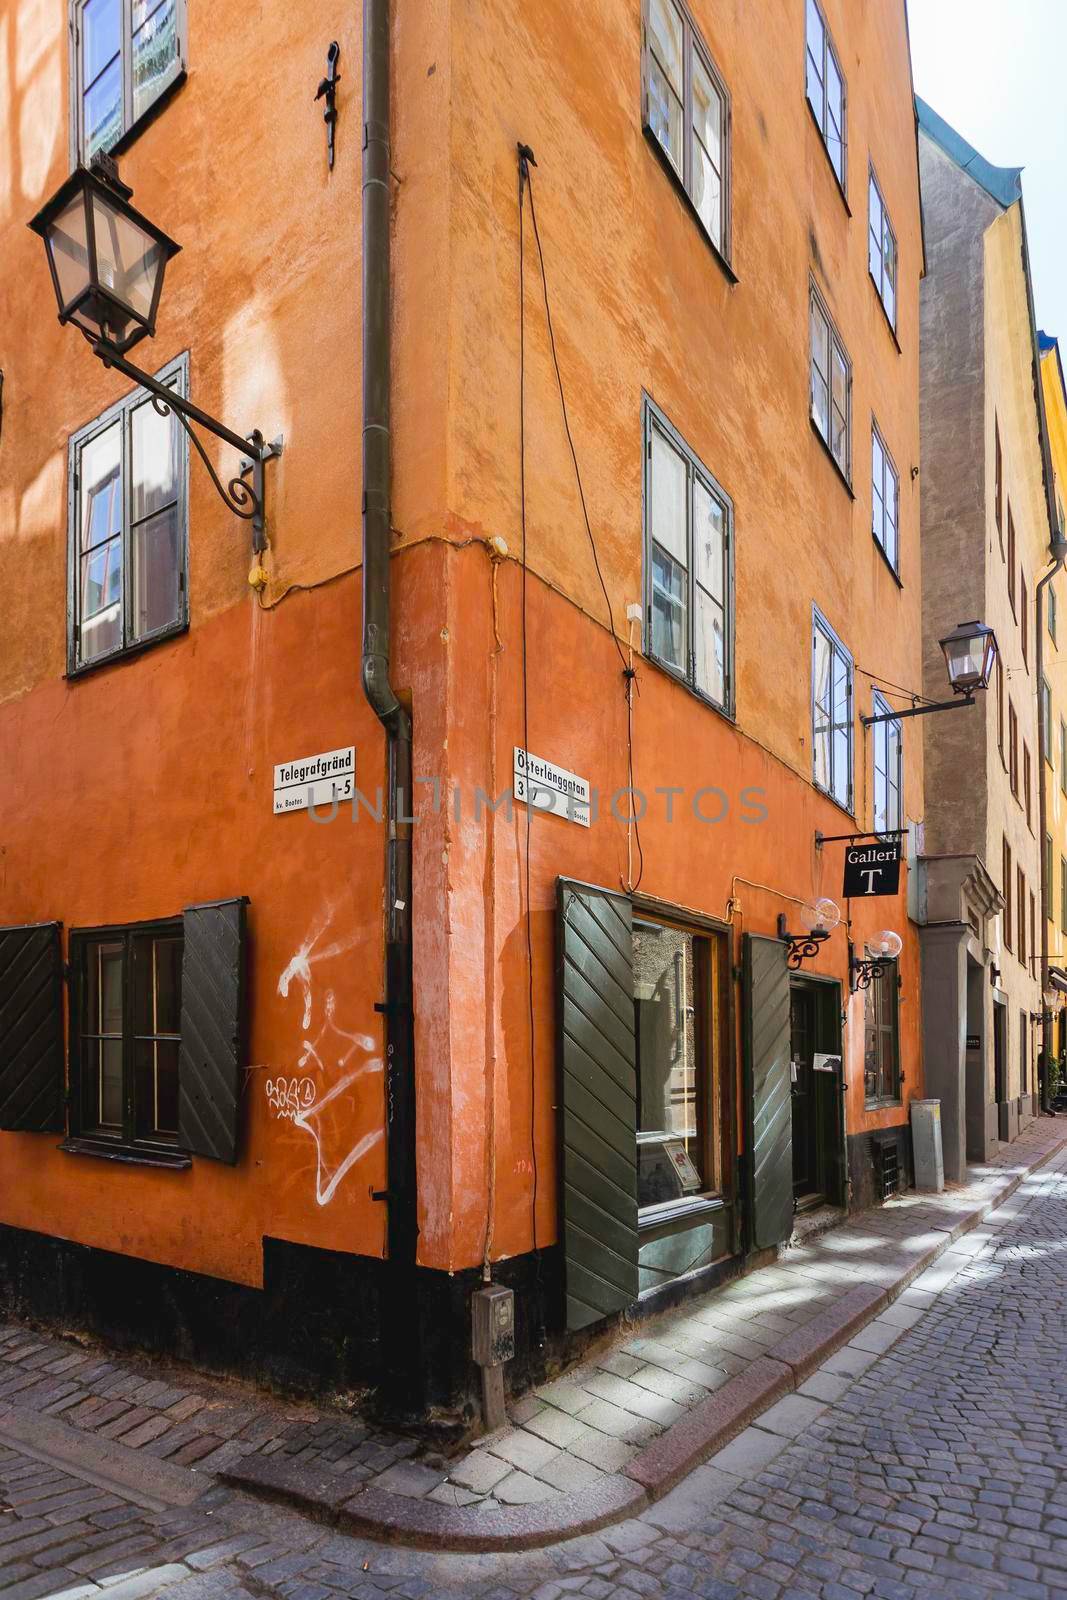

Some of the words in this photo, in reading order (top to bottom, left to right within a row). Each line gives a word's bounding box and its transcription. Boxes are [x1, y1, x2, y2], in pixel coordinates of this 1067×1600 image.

[280, 751, 352, 782] Telegrafgränd
[517, 749, 586, 796] Österlånggatan
[332, 780, 351, 798] 1-5
[285, 799, 303, 808] Bootes
[848, 848, 897, 864] Galleri
[860, 869, 883, 894] T
